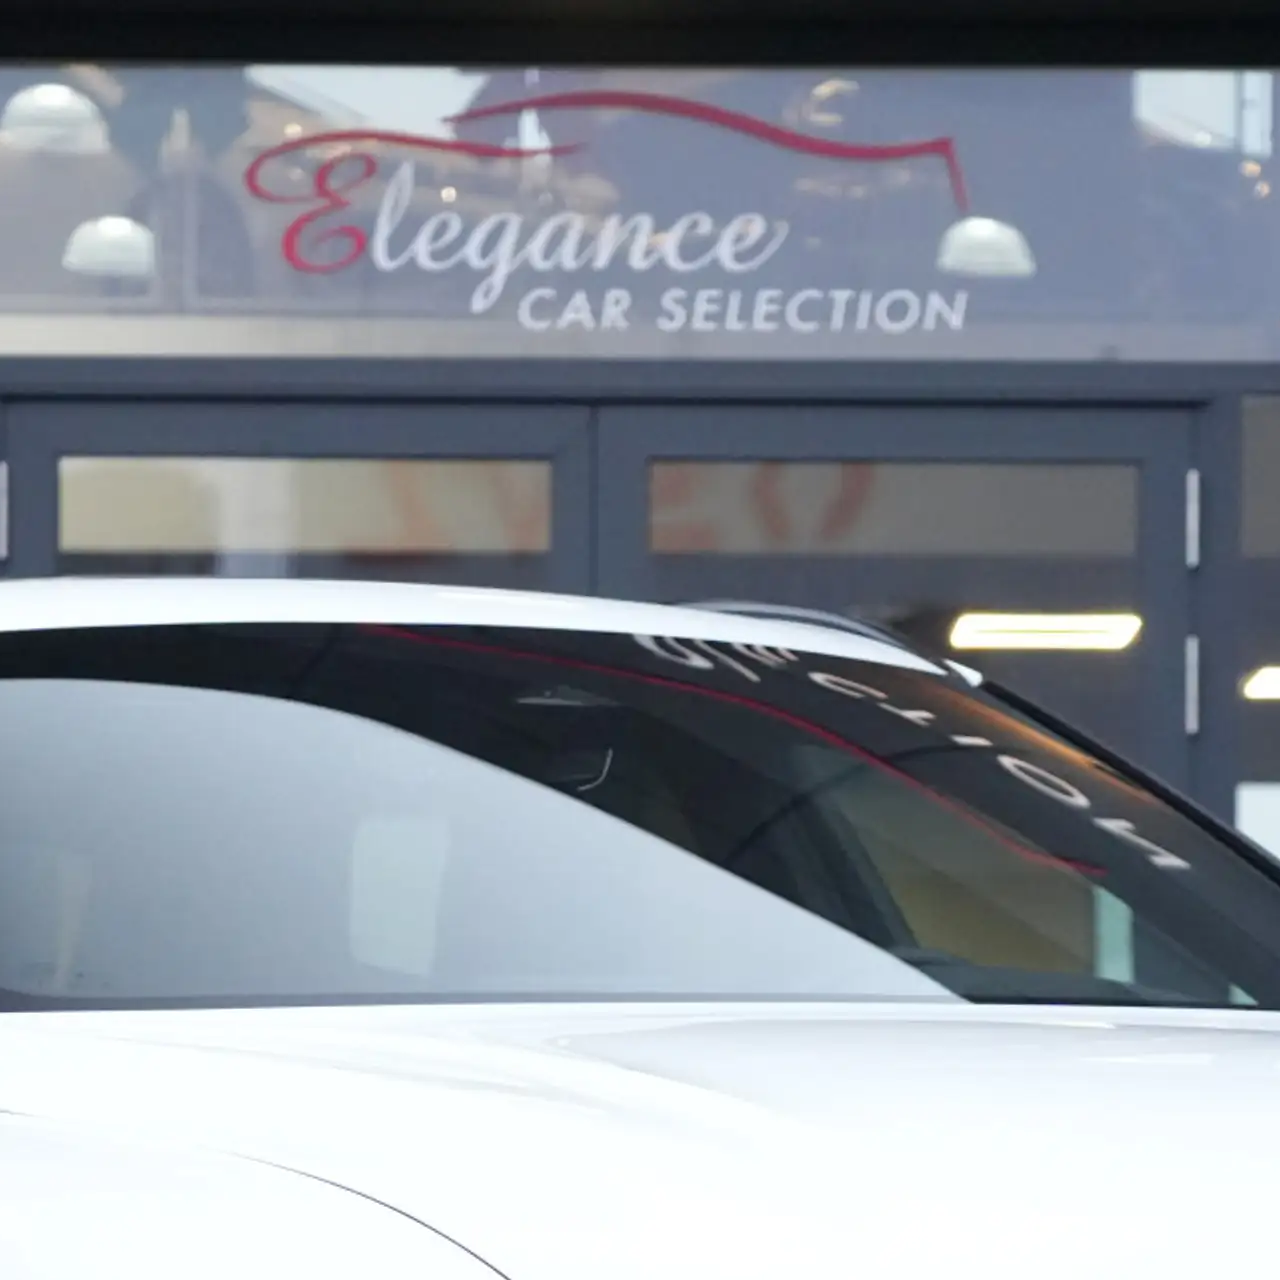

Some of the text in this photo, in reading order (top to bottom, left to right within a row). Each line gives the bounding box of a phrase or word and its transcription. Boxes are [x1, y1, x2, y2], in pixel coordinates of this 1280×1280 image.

[247, 151, 788, 314] Elegance
[518, 287, 968, 334] CAR SELECTION
